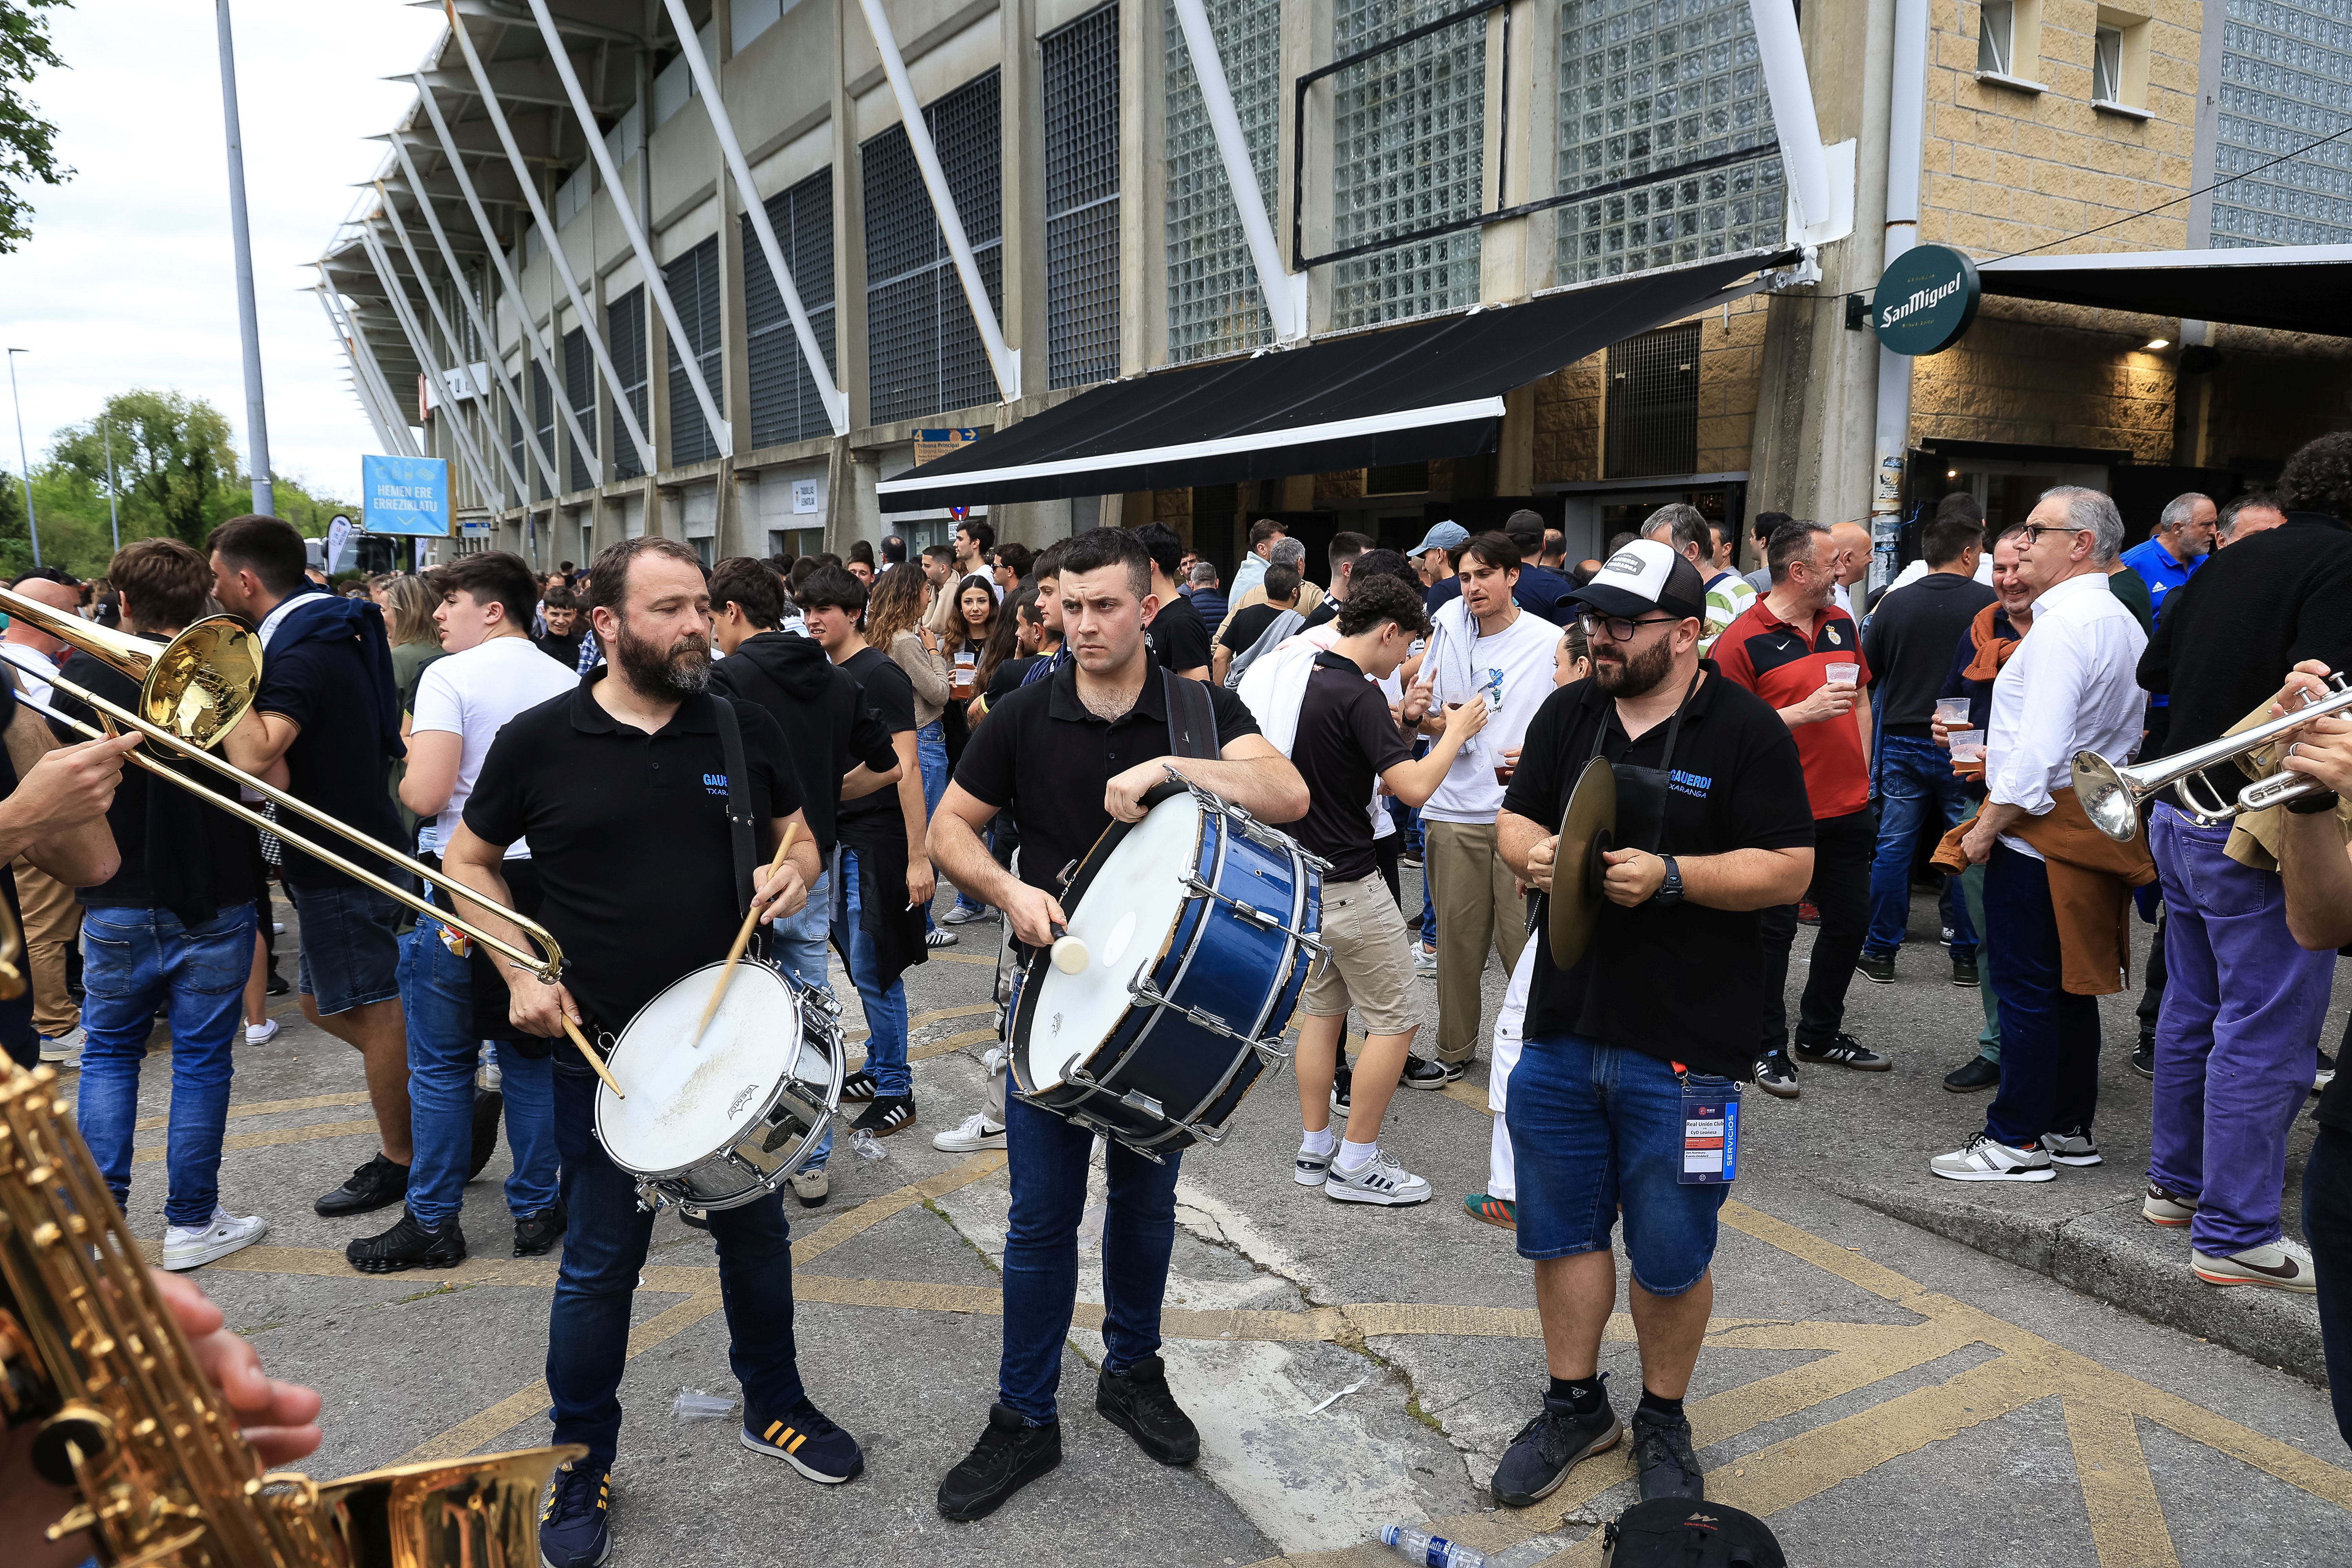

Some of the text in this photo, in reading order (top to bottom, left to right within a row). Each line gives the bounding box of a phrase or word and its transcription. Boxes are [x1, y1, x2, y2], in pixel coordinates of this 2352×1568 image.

[377, 484, 433, 499] HEMEN ERE
[374, 498, 438, 512] ERREZIKLATU
[703, 774, 728, 787] GAUE
[1670, 769, 1712, 789] GAUERDI
[1668, 783, 1706, 799] XARANGA
[730, 1087, 752, 1112] REMO
